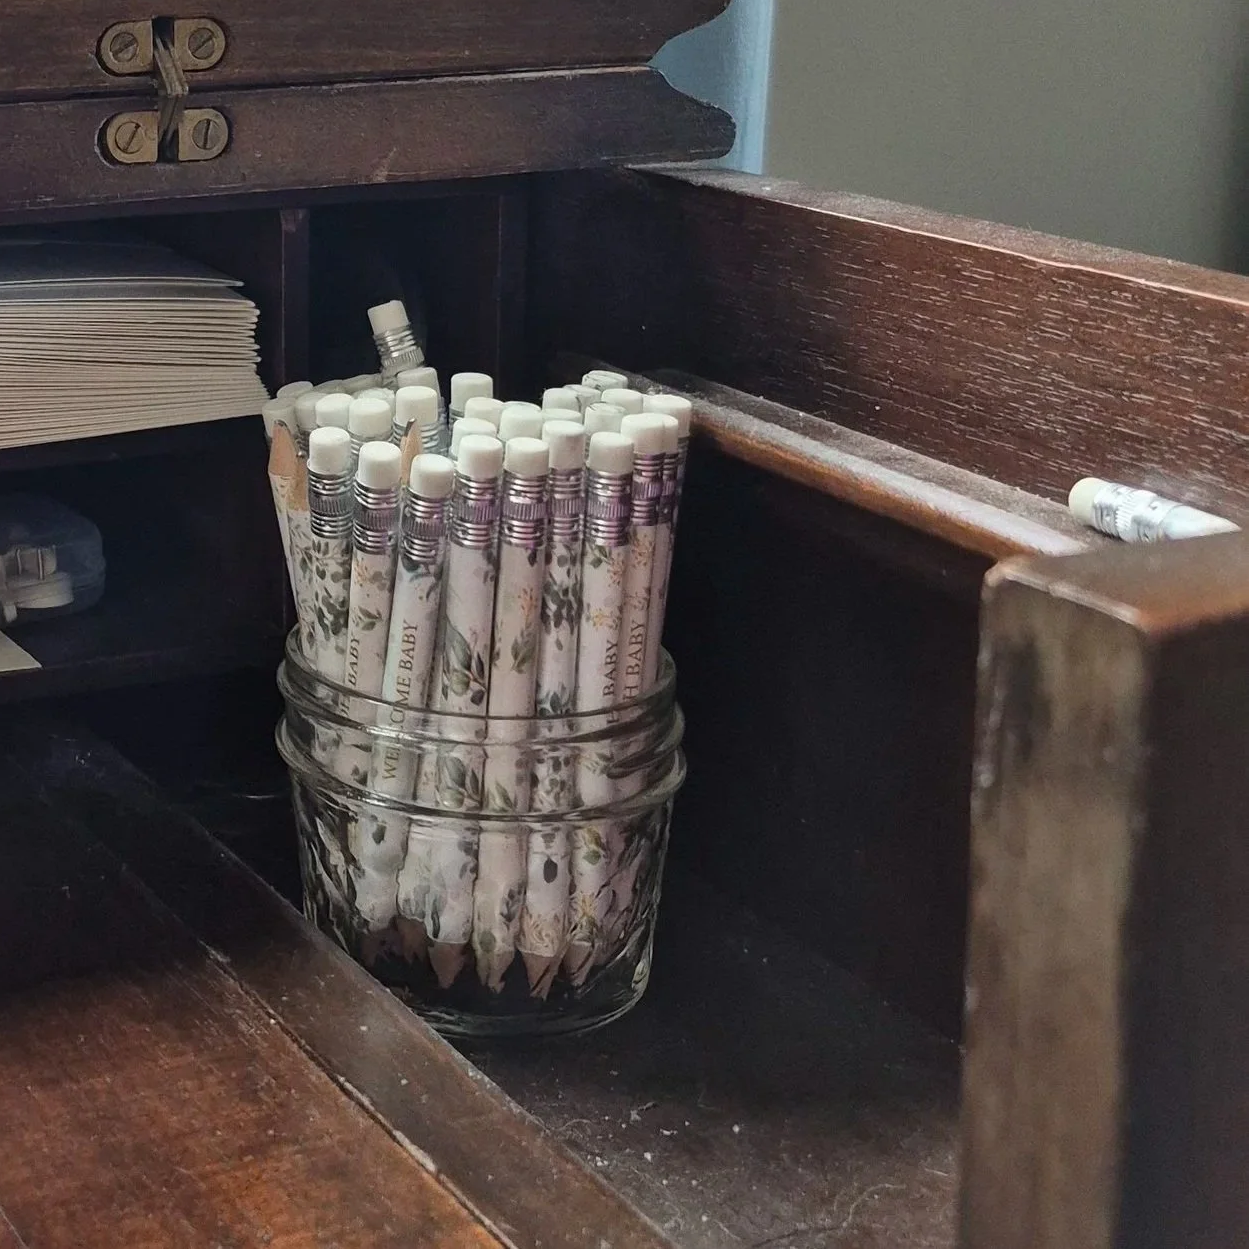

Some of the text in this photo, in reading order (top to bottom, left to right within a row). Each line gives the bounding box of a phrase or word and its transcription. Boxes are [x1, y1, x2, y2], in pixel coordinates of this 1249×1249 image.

[398, 618, 418, 671] BABY
[603, 639, 618, 697] BABY
[626, 619, 645, 675] BABY
